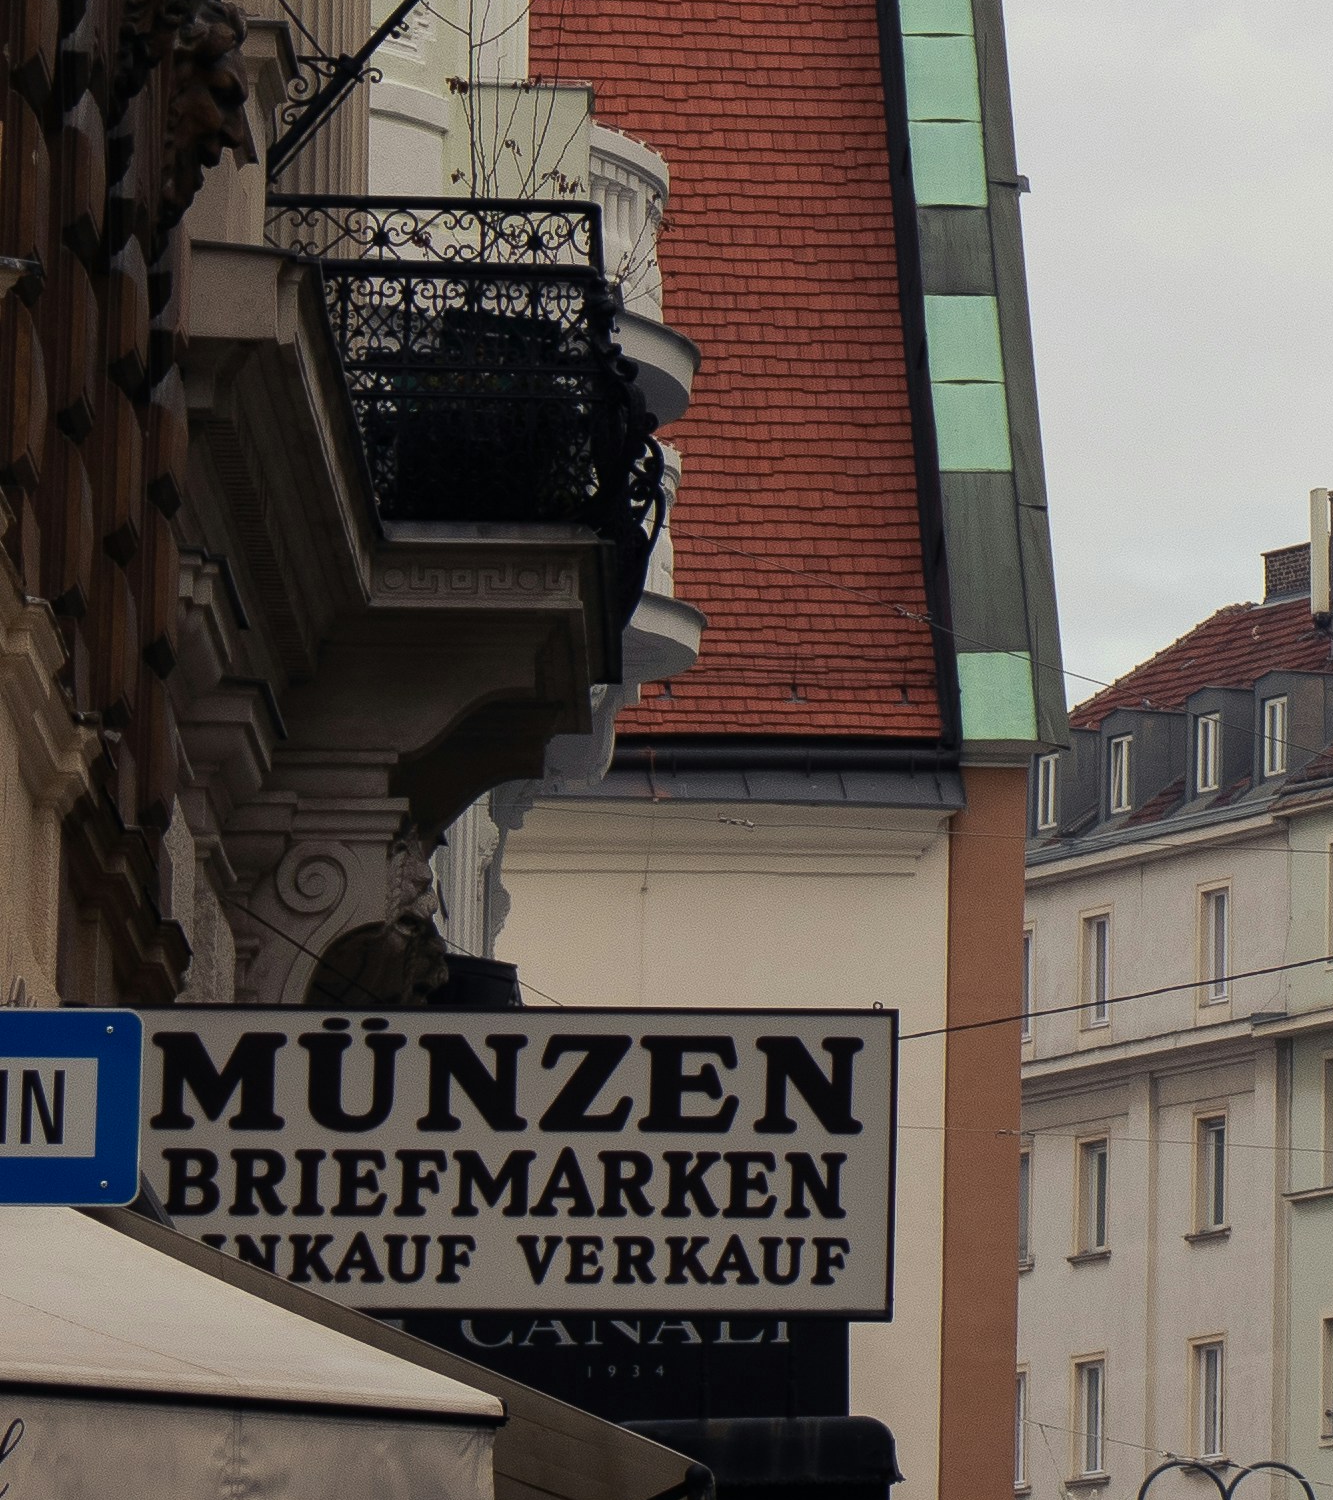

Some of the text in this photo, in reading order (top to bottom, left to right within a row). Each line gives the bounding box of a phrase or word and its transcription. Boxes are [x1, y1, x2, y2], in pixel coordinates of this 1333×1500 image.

[150, 1017, 864, 1135] MÜNZEN
[161, 1147, 848, 1219] BRIEFMARKEN
[516, 1234, 851, 1285] VERKAUF
